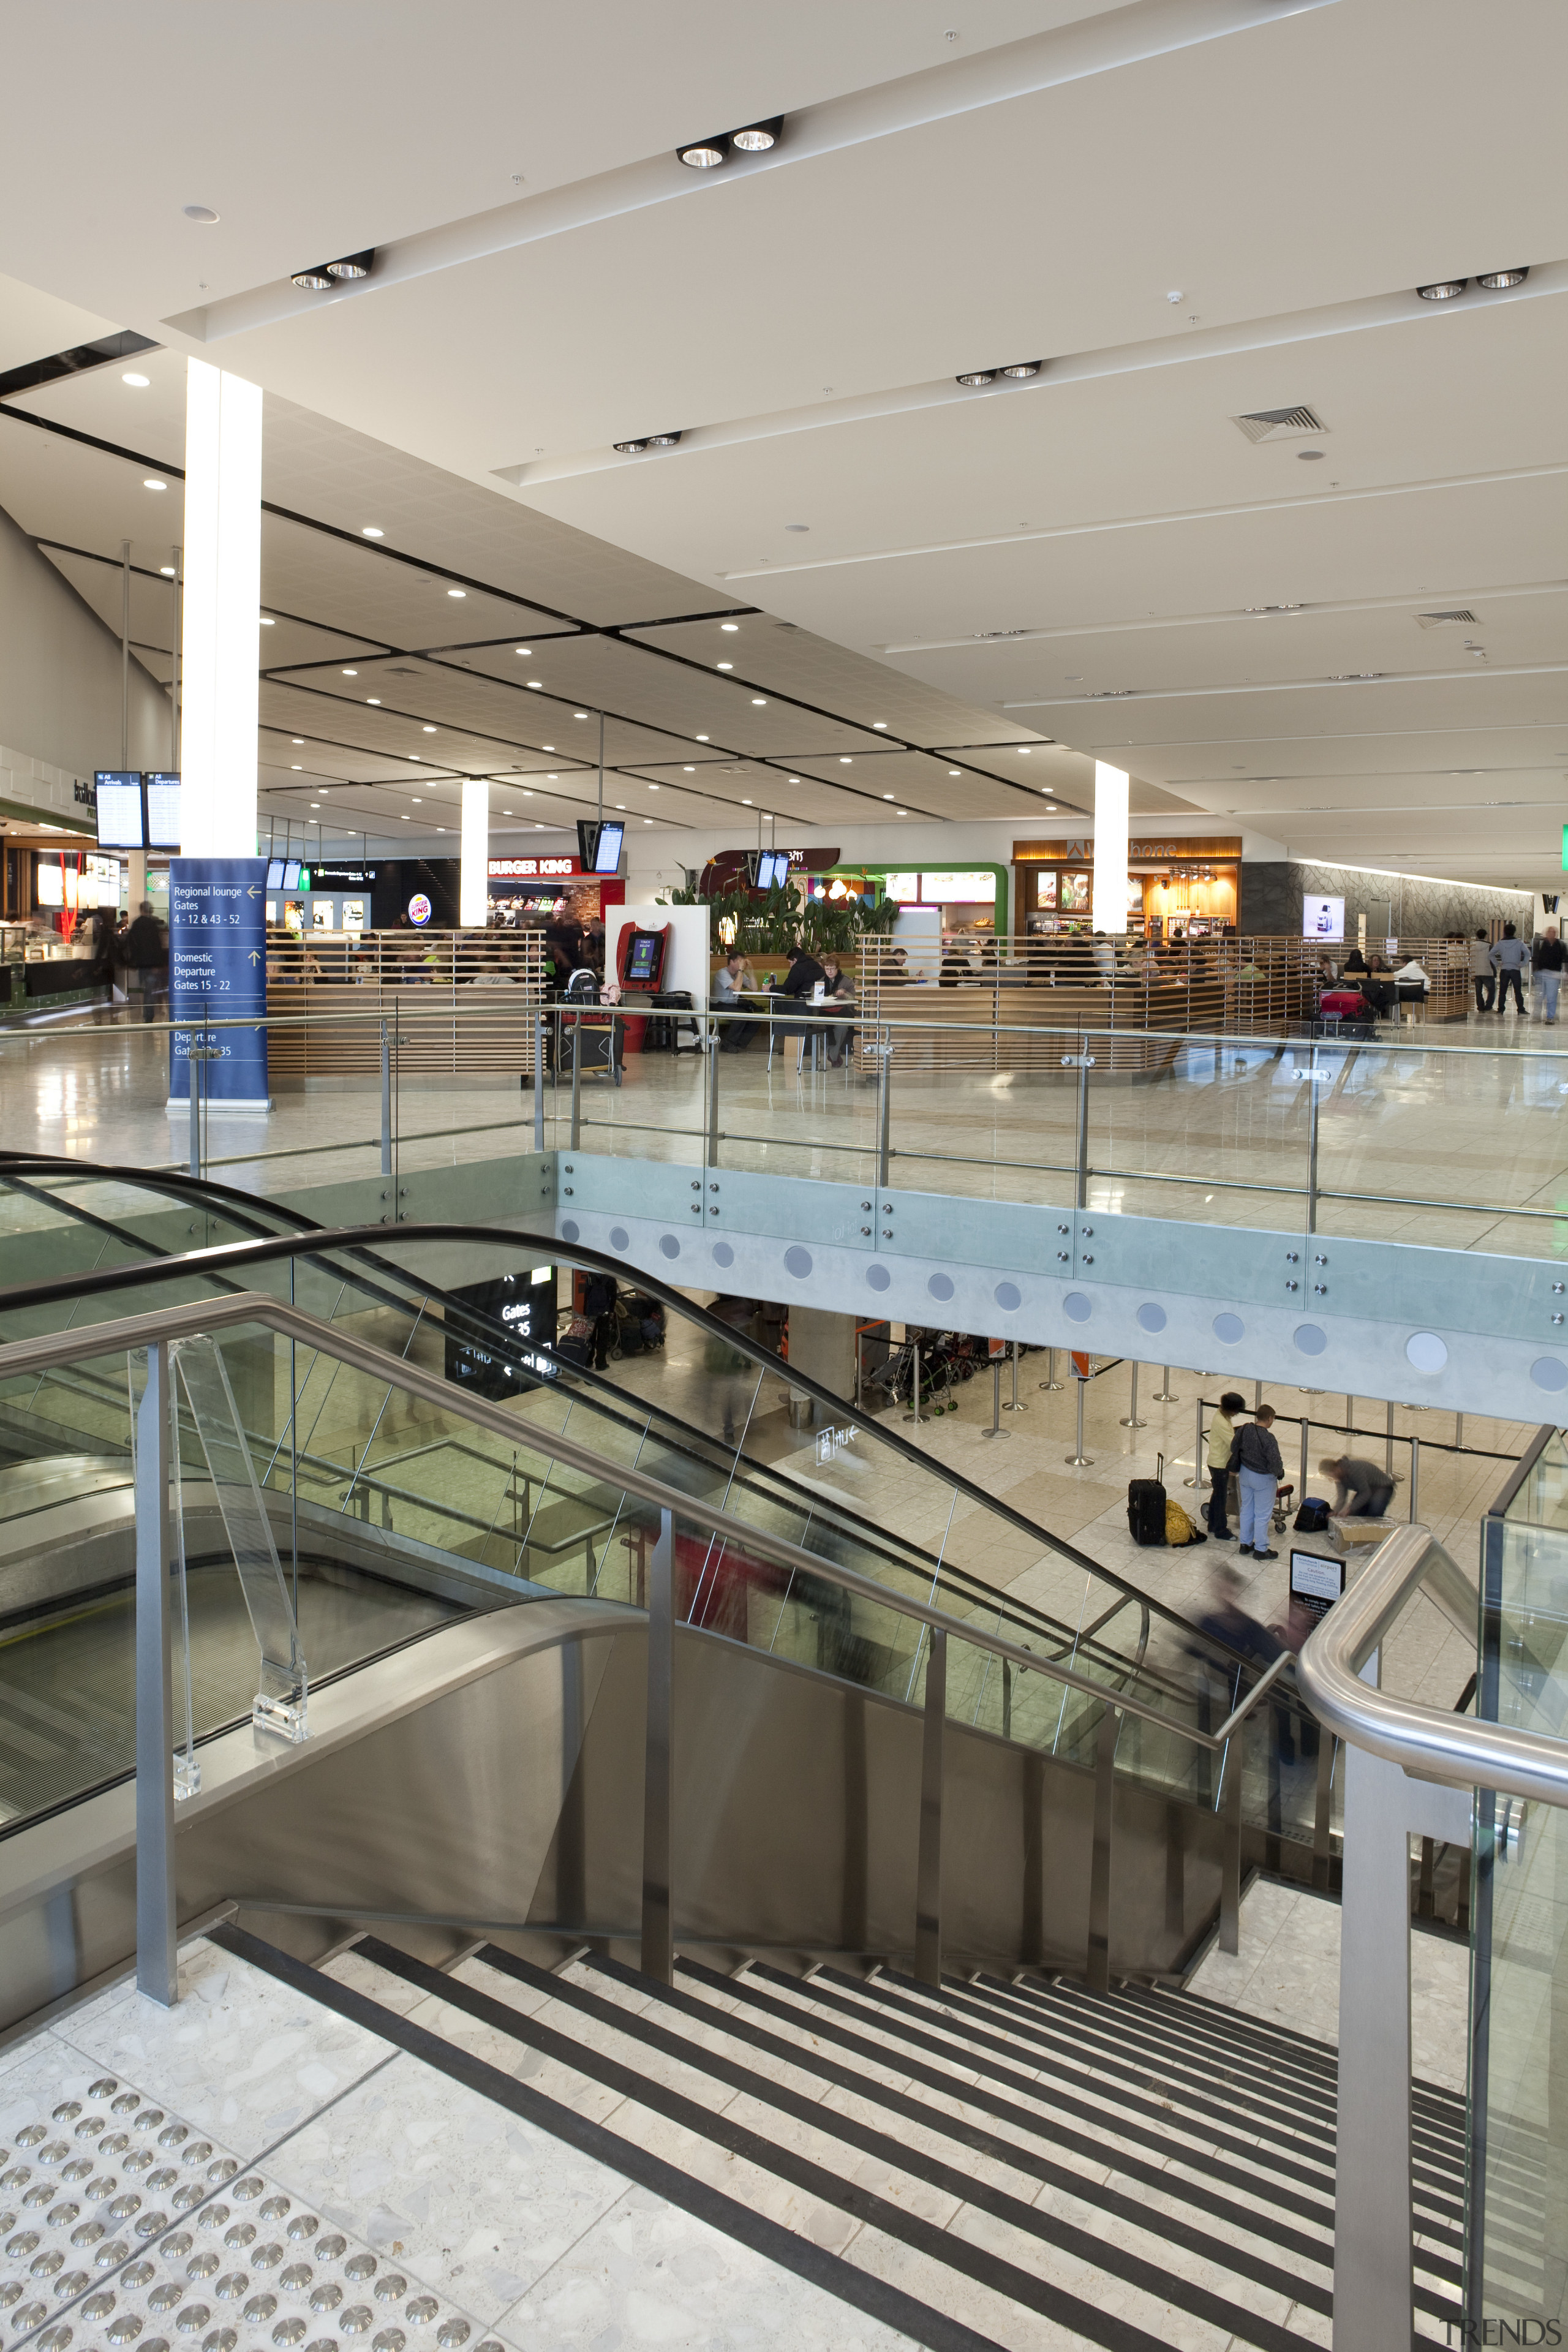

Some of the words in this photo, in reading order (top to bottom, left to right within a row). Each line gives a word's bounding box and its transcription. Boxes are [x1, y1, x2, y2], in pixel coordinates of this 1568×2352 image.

[489, 860, 537, 875] BURGER
[539, 859, 572, 874] KING
[174, 887, 210, 898] Regional
[213, 887, 242, 898] lounge
[174, 901, 198, 910] Gates
[411, 900, 427, 910] BURGER
[412, 906, 428, 918] KING
[174, 915, 180, 923] 4
[188, 915, 198, 923] 12
[201, 915, 208, 924] &
[210, 915, 221, 924] 43
[229, 915, 240, 924] 52
[174, 952, 213, 962] Domestic
[174, 966, 216, 978] Departure
[174, 980, 198, 989] Gates
[201, 981, 211, 990] 15
[219, 981, 230, 990] 22
[221, 1046, 231, 1056] 35
[502, 1304, 530, 1321] Gates
